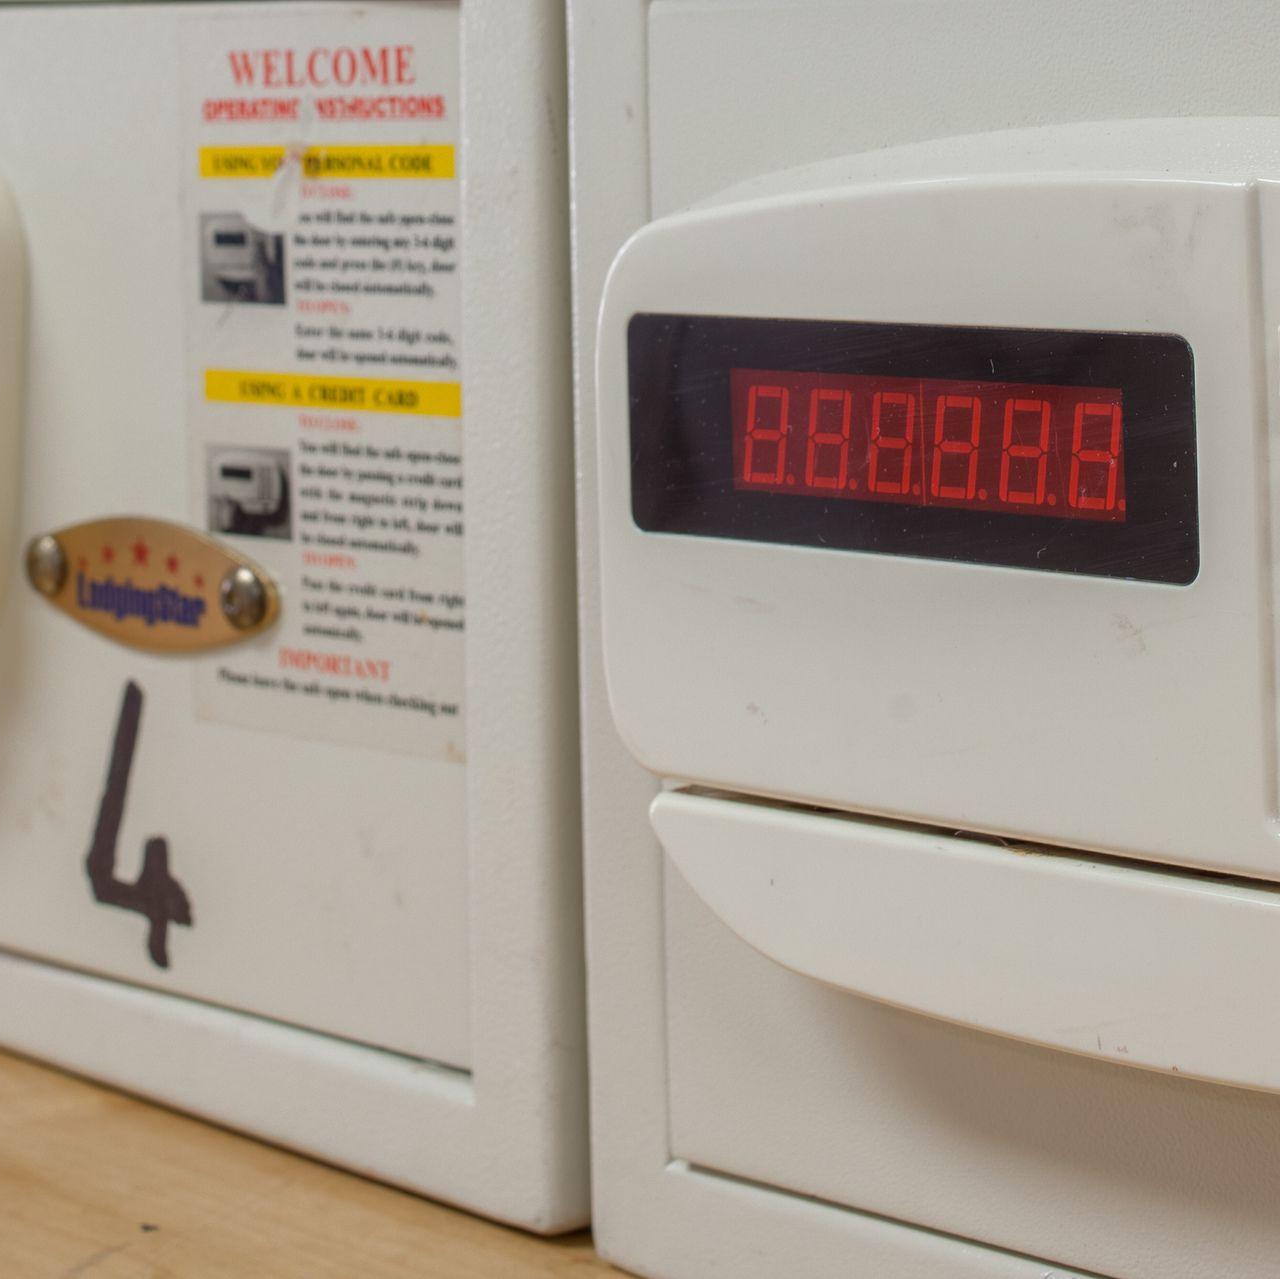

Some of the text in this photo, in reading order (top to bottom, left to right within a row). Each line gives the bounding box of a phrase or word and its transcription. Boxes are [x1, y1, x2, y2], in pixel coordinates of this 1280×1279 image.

[227, 45, 416, 88] WELCOME
[293, 383, 306, 401] A
[308, 383, 366, 405] CREDIT
[373, 385, 419, 408] CARD
[278, 647, 391, 683] IMPORTANT
[85, 679, 193, 969] 4
